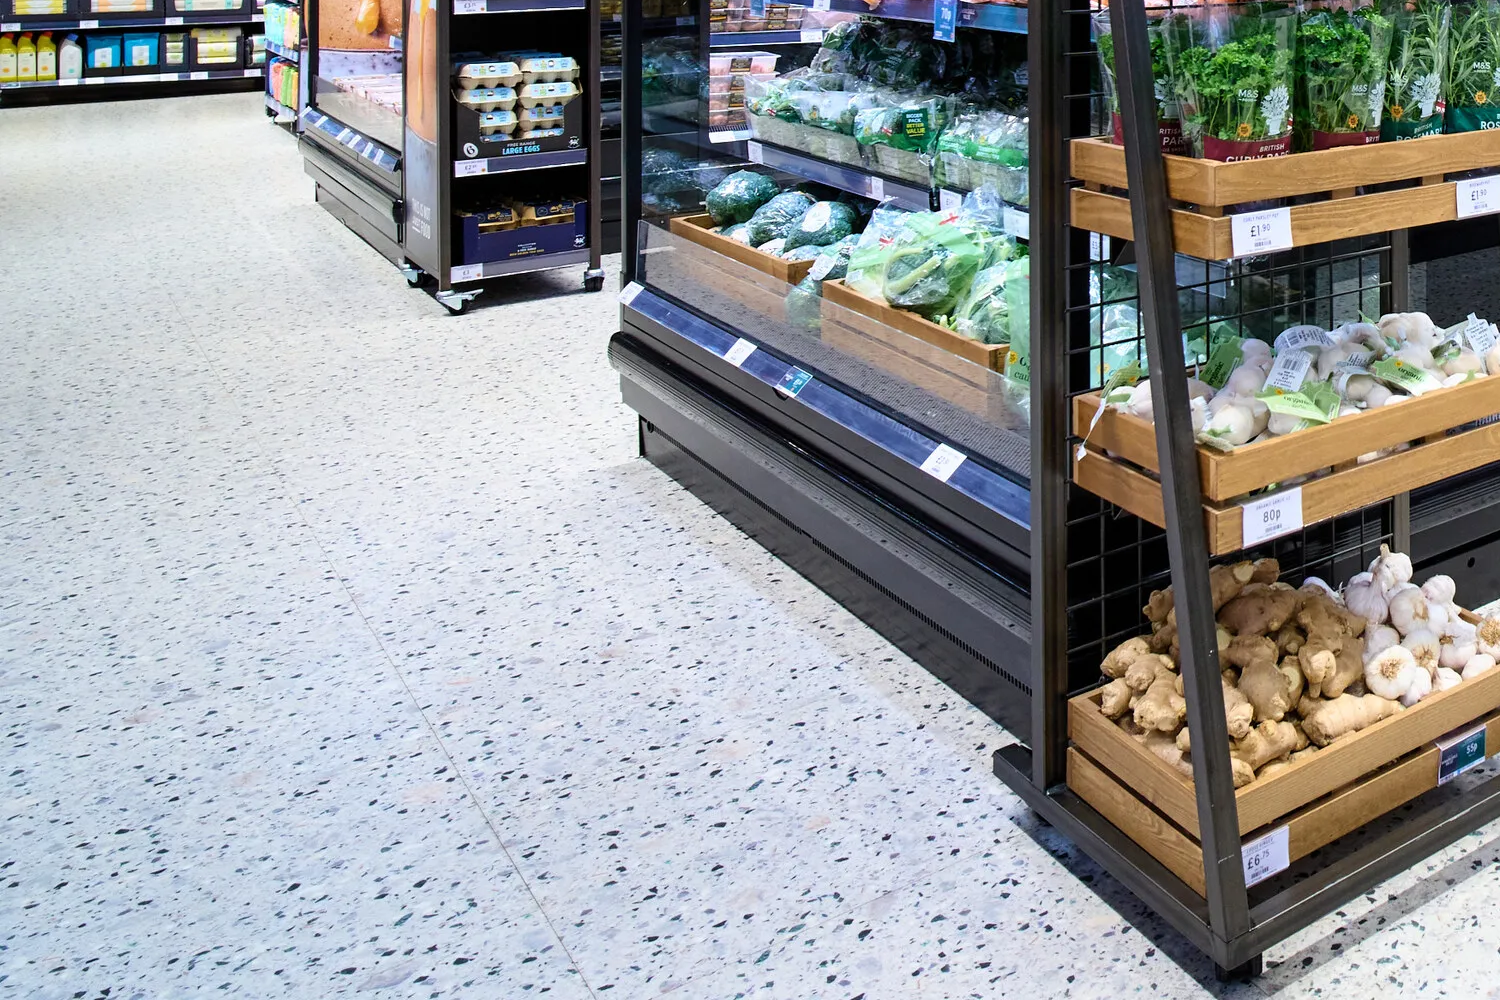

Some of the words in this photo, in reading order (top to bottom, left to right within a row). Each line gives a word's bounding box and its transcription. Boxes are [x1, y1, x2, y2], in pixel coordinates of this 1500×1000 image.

[1473, 61, 1491, 70] M&S
[1239, 89, 1259, 98] M&S
[1352, 84, 1368, 92] M&S
[467, 144, 475, 154] 6
[503, 147, 523, 155] LARGE
[1260, 143, 1285, 152] BRITISH
[1471, 189, 1487, 201] £1.90
[423, 206, 431, 220] NOT
[420, 220, 431, 240] FOOD
[1251, 224, 1271, 237] £1.90
[1263, 509, 1281, 524] 80p
[1247, 849, 1270, 870] £6.75
